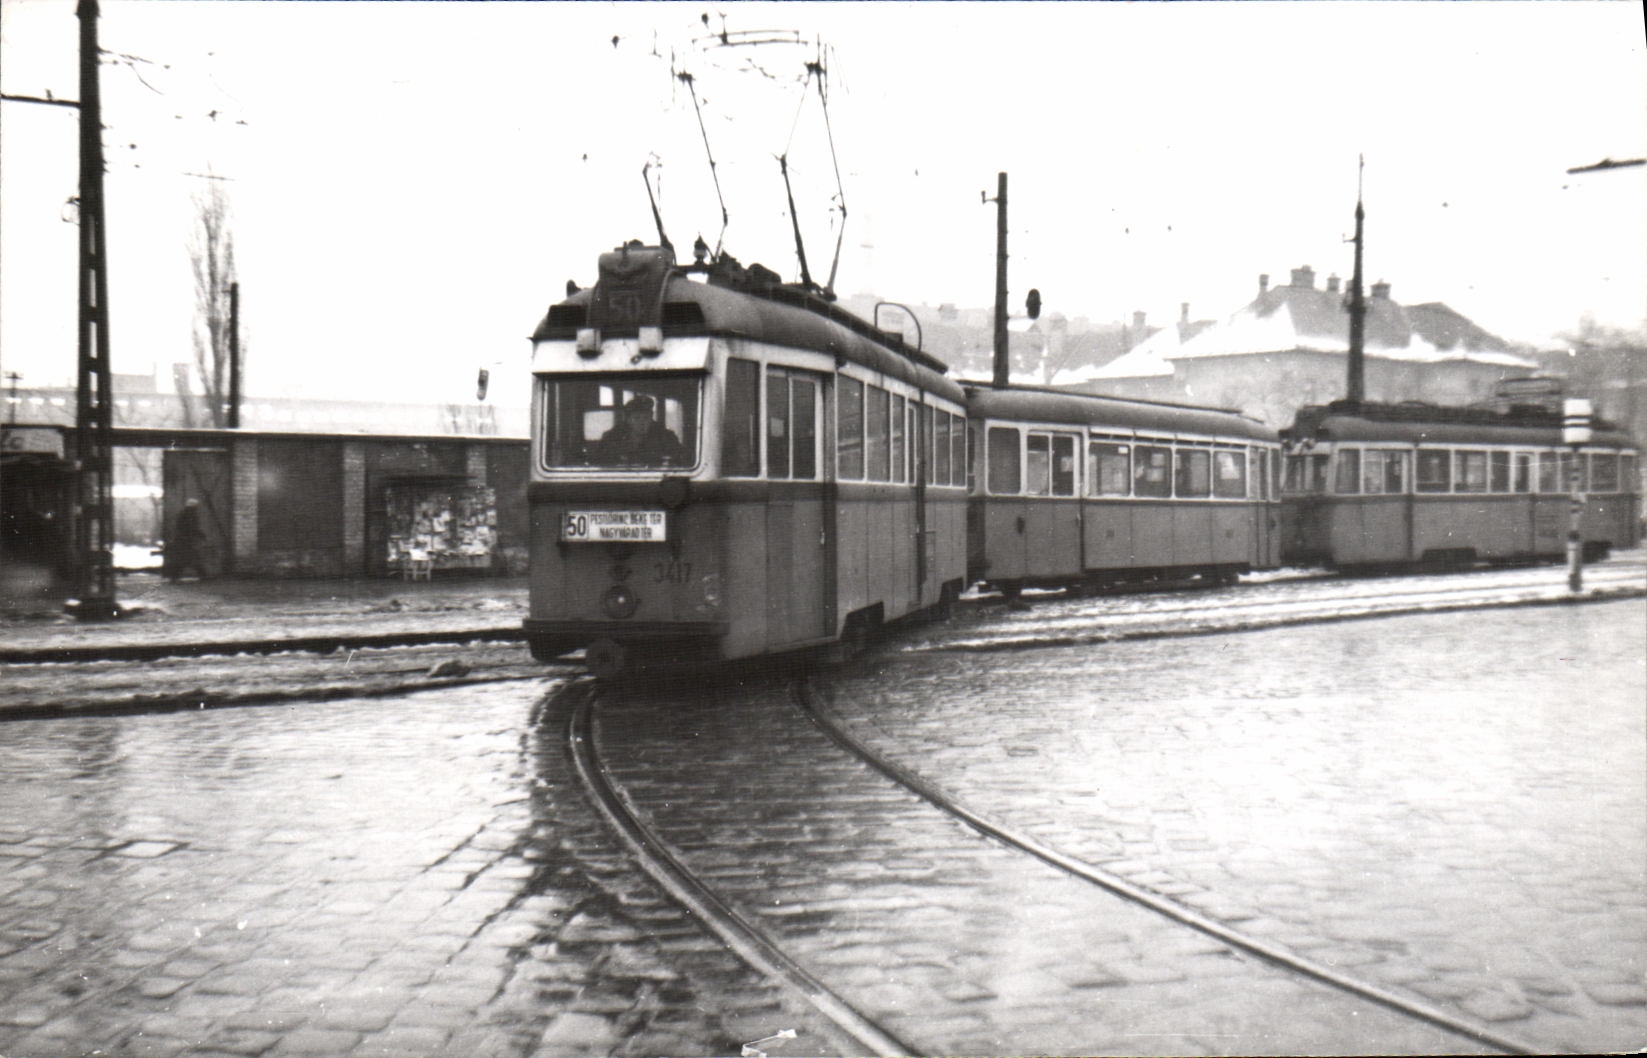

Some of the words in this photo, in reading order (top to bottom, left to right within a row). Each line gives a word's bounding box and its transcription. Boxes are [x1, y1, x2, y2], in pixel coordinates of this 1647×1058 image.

[609, 295, 641, 322] 50
[567, 514, 587, 537] 50
[654, 563, 691, 584] 3417
